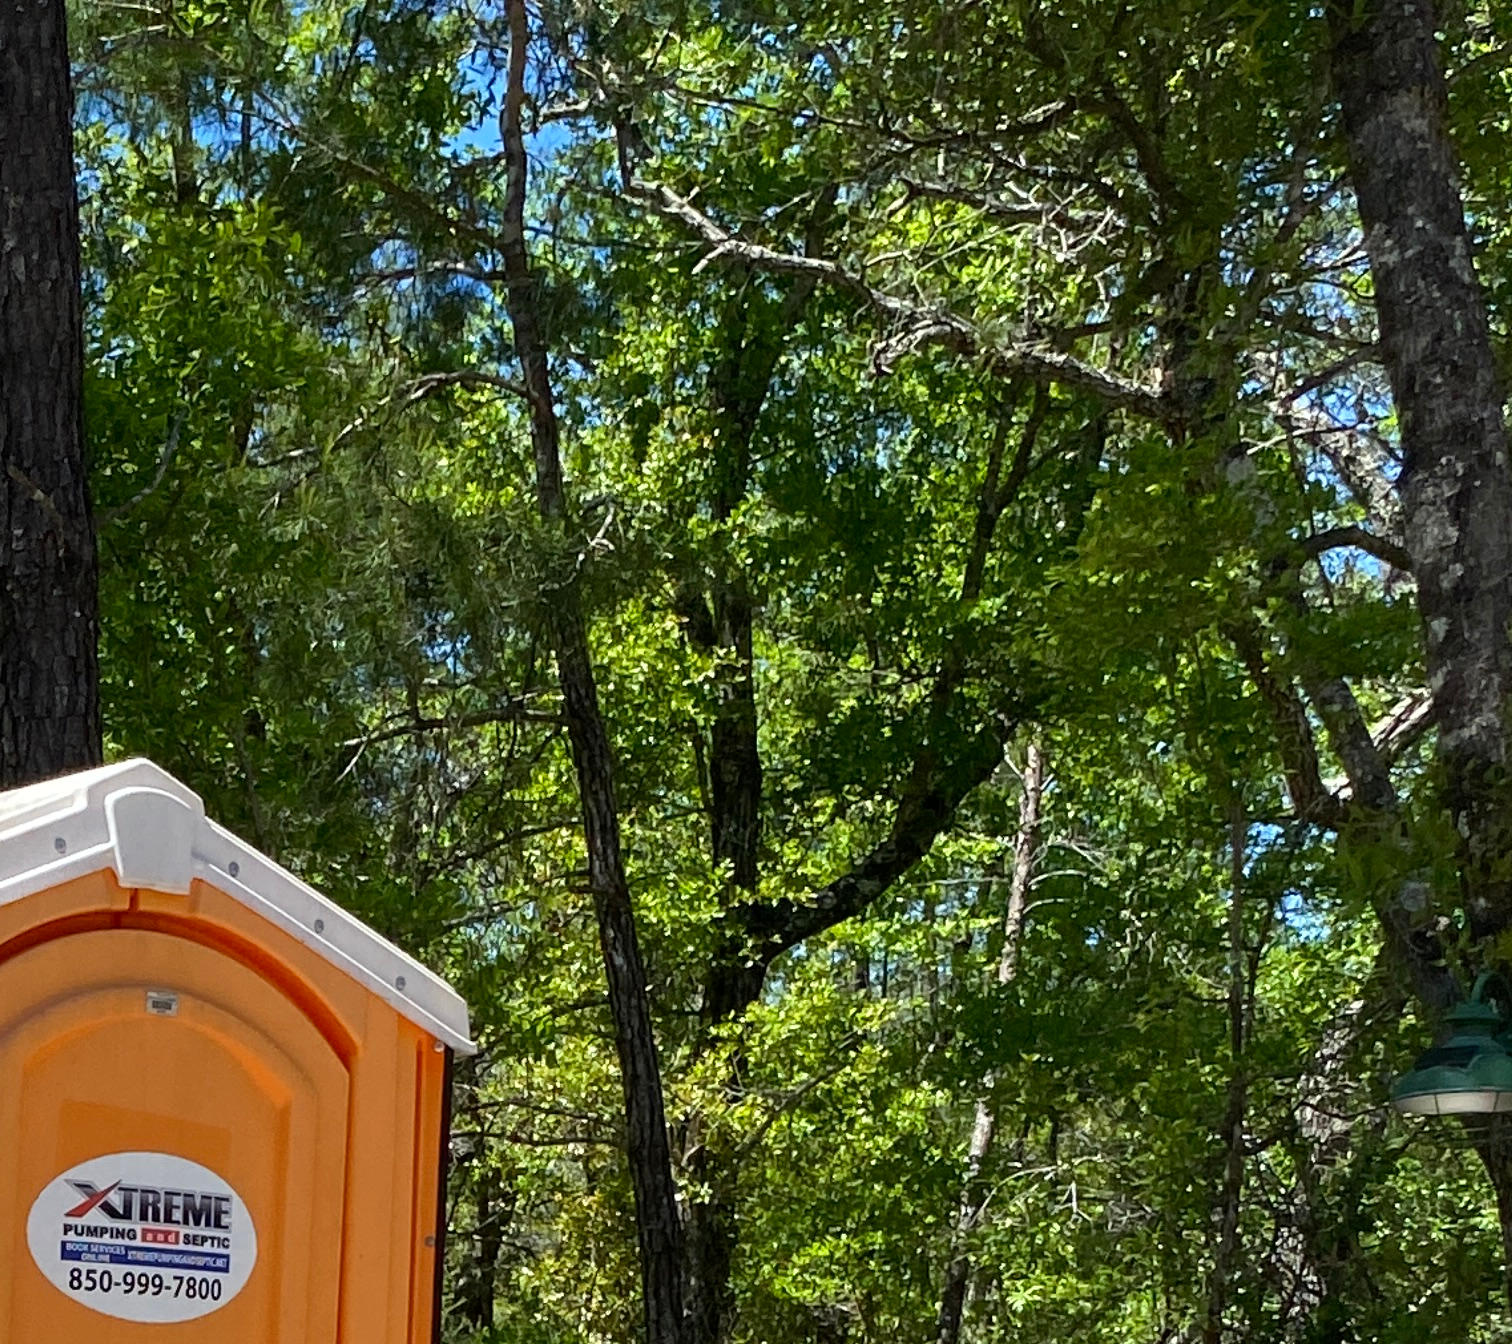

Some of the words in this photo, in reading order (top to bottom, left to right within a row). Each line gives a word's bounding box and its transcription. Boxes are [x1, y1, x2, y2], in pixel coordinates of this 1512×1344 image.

[64, 1178, 232, 1233] XTREME
[63, 1224, 137, 1240] PUMPING
[146, 1232, 176, 1242] and
[183, 1233, 230, 1249] SEPTIC
[66, 1243, 88, 1251] BOOK
[90, 1244, 125, 1255] SERVICES
[69, 1267, 222, 1301] 850-999-7800
